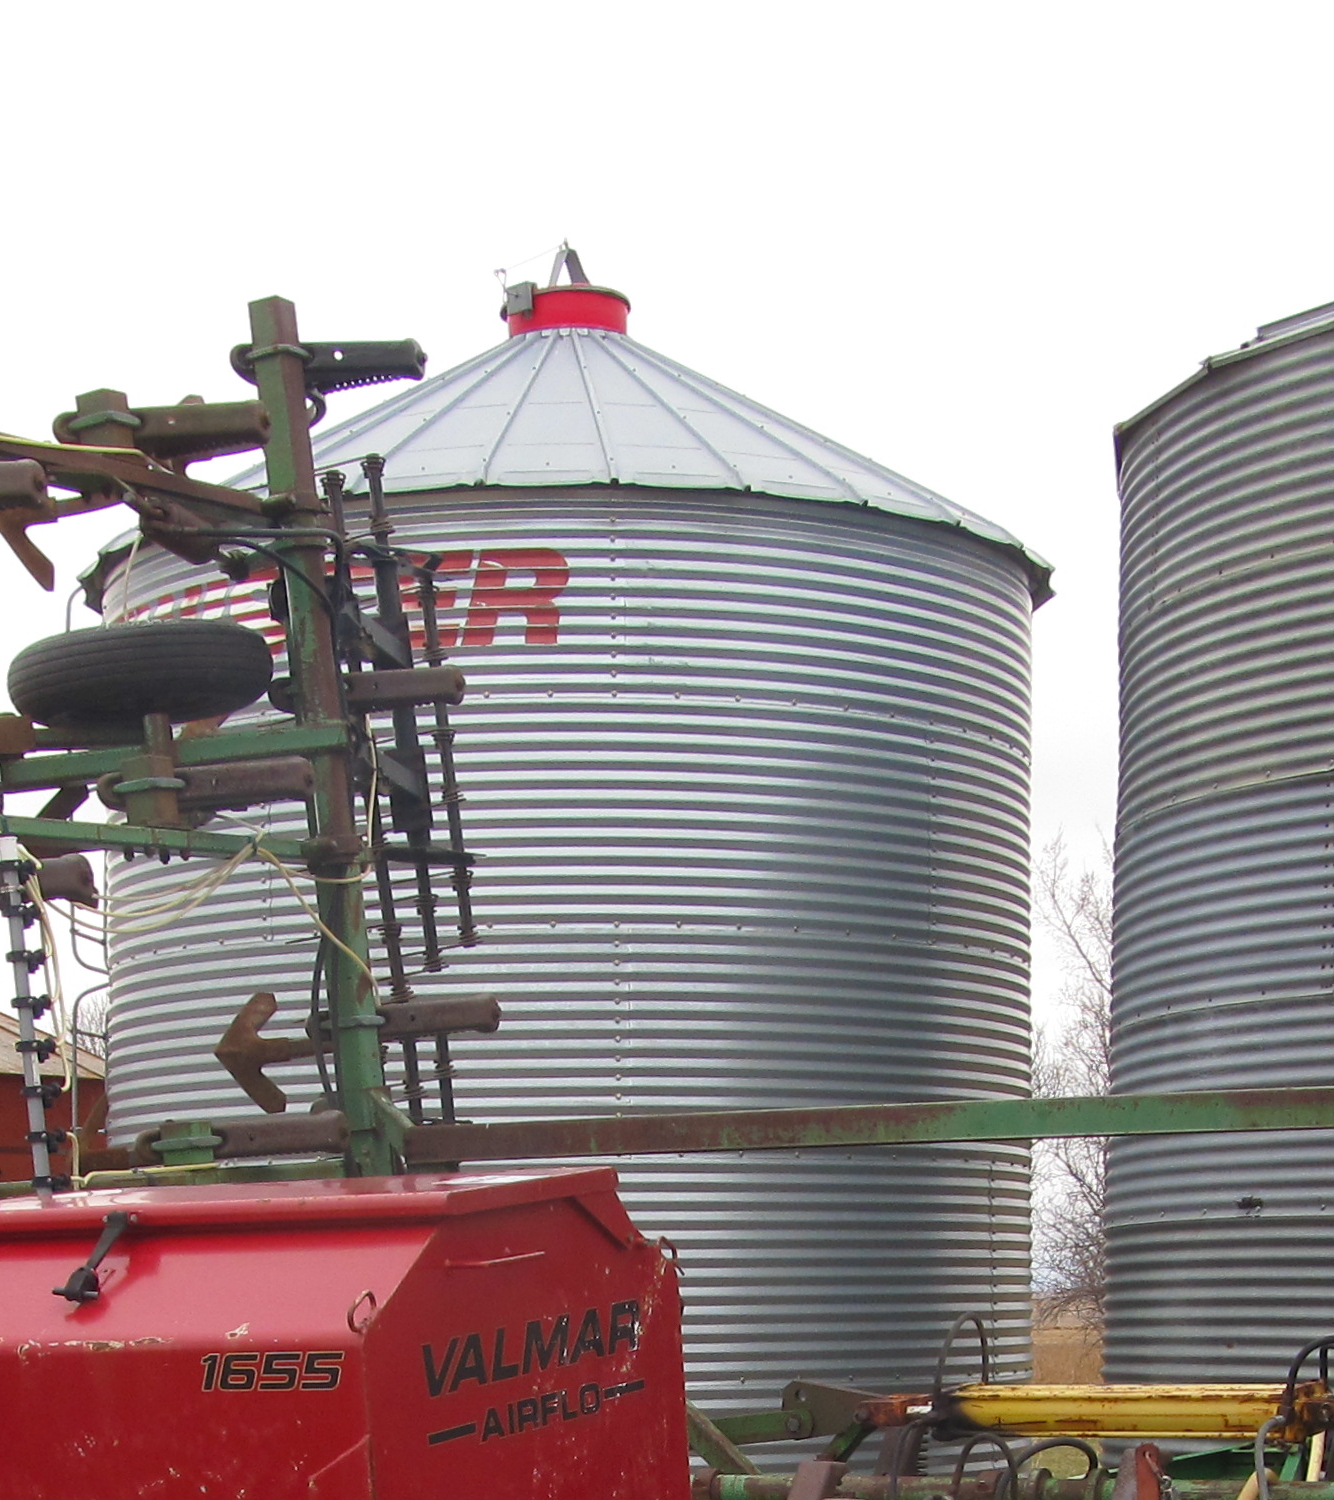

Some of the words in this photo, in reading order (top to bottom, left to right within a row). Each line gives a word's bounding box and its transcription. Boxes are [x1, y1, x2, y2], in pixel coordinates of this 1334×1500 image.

[201, 1351, 345, 1392] 1655
[421, 1299, 641, 1397] VALMAR
[480, 1382, 602, 1445] AIRFLO
